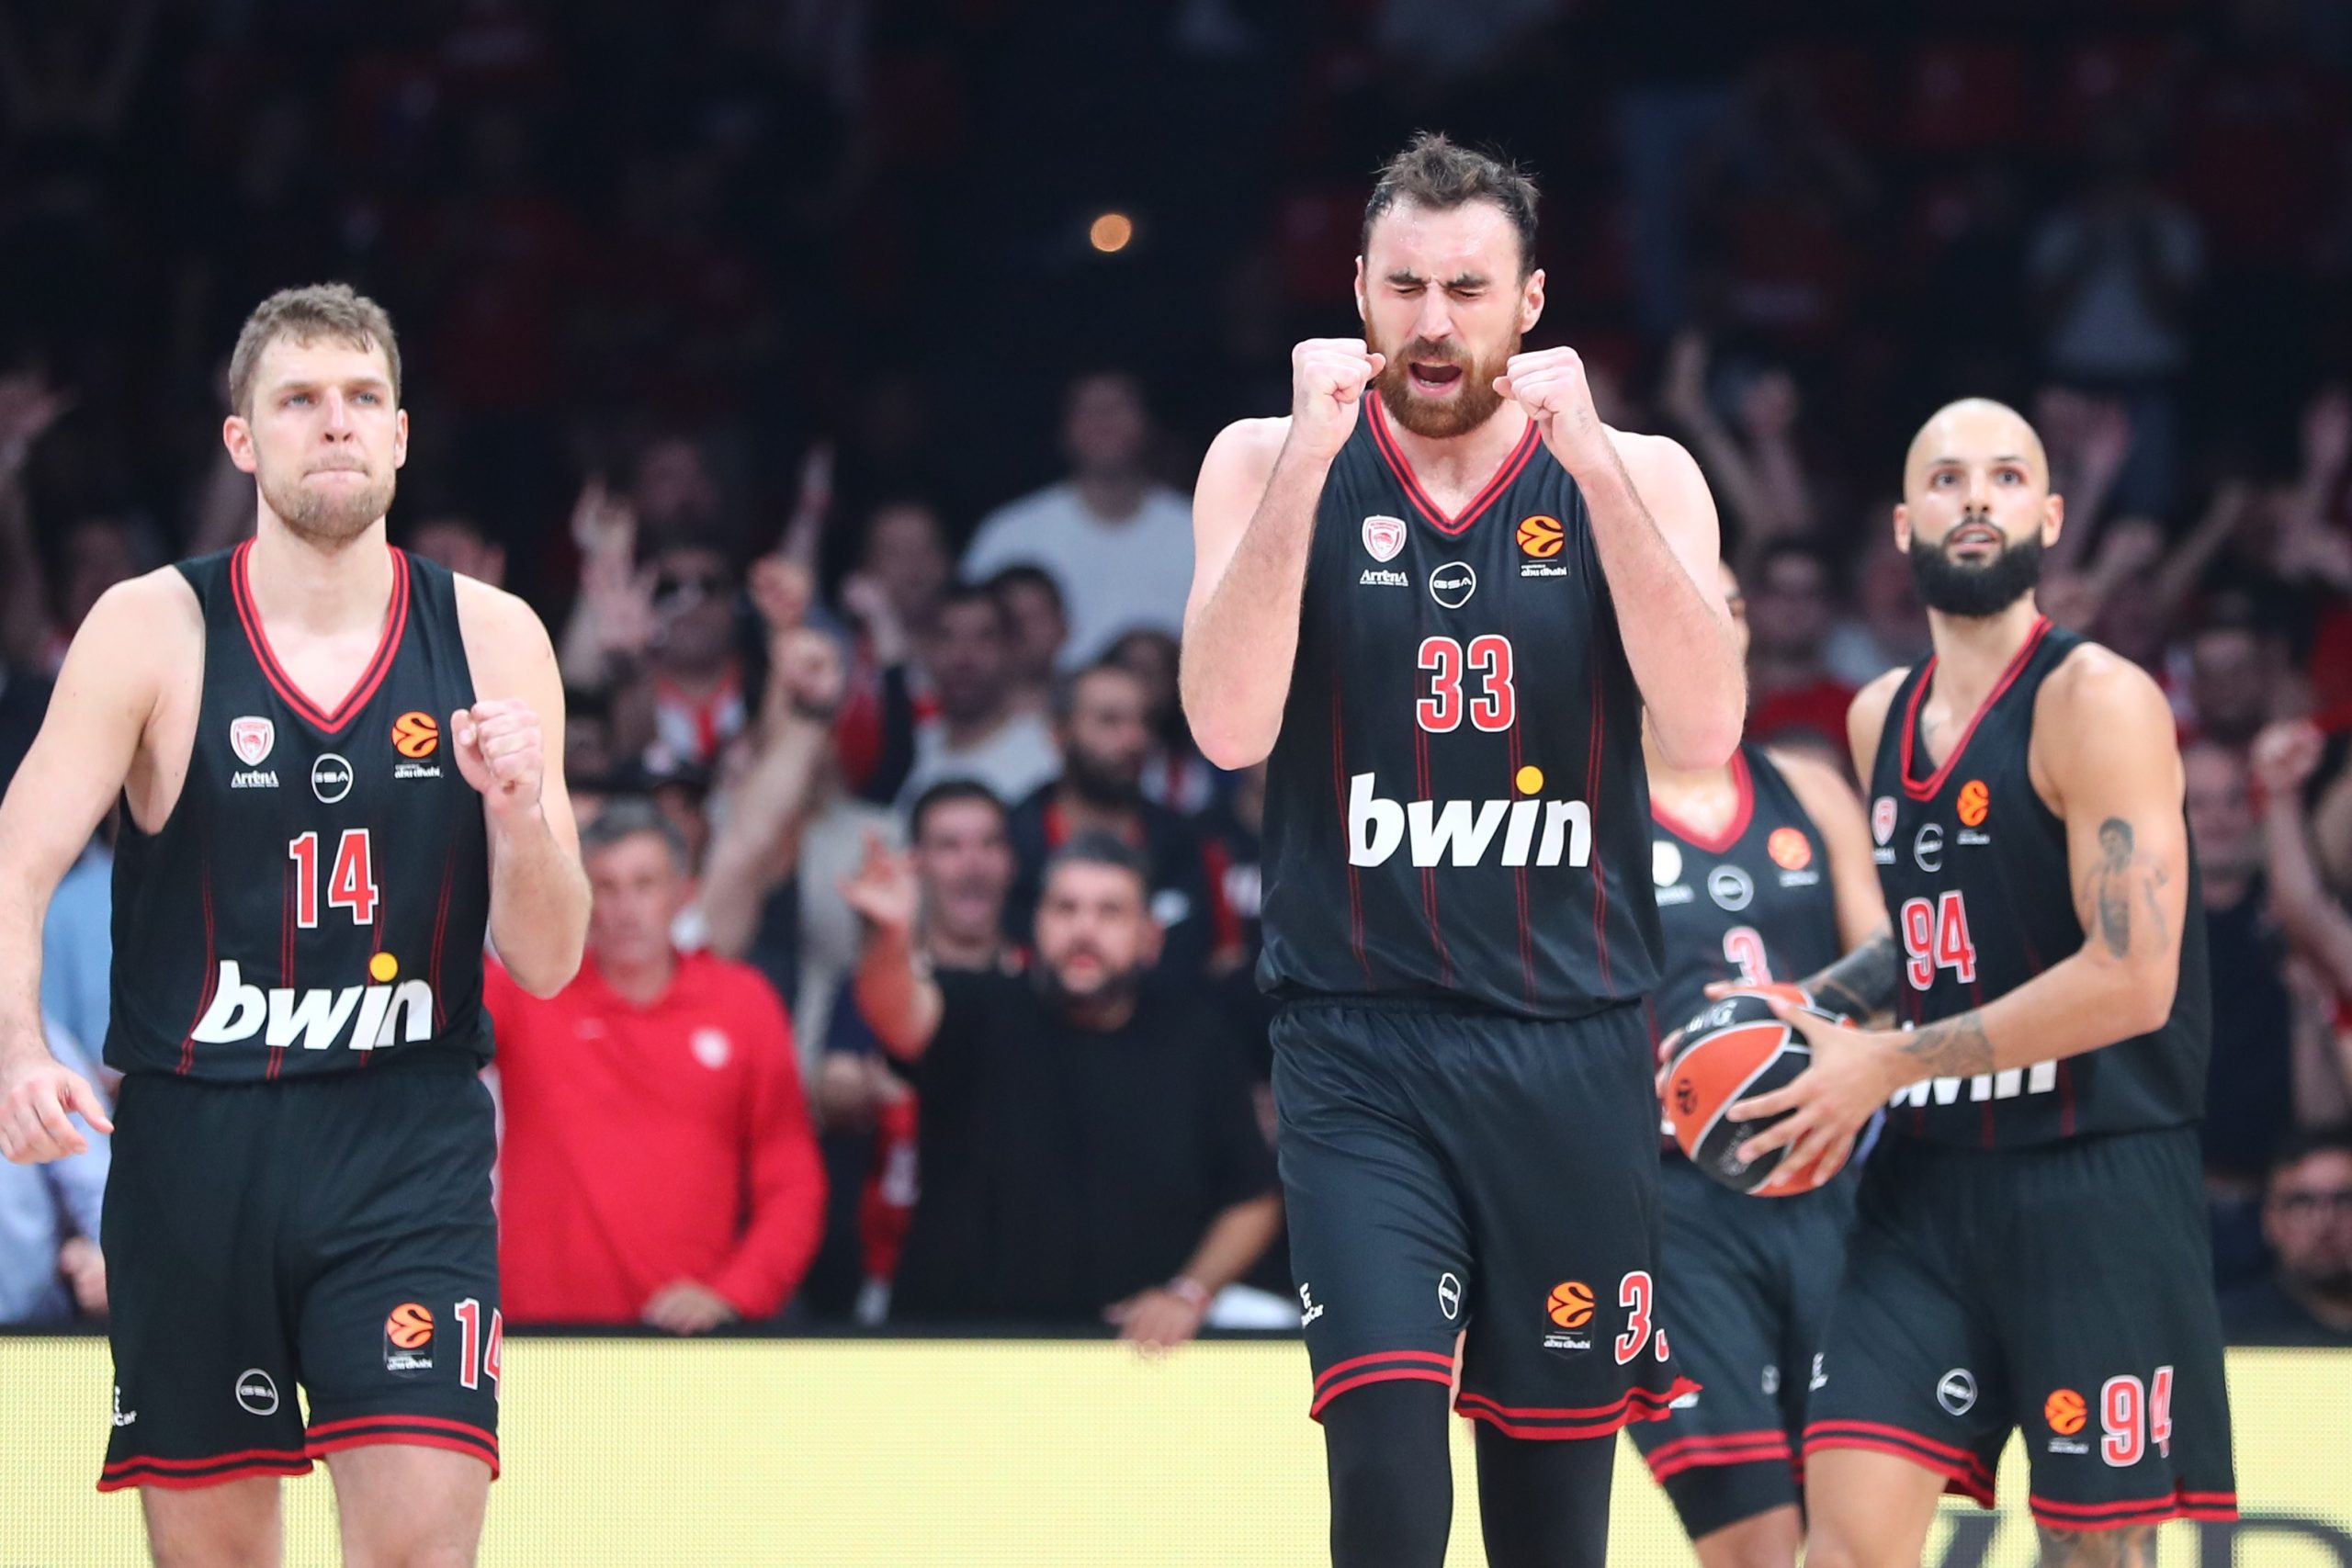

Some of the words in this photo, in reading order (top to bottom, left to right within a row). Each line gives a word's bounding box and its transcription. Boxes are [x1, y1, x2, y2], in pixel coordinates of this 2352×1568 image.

[1416, 635, 1515, 732] 33
[1349, 766, 1590, 866] bwin
[289, 829, 378, 928] 14
[1901, 890, 1975, 990] 94
[191, 953, 432, 1050] bwin
[1615, 1271, 1669, 1365] 3
